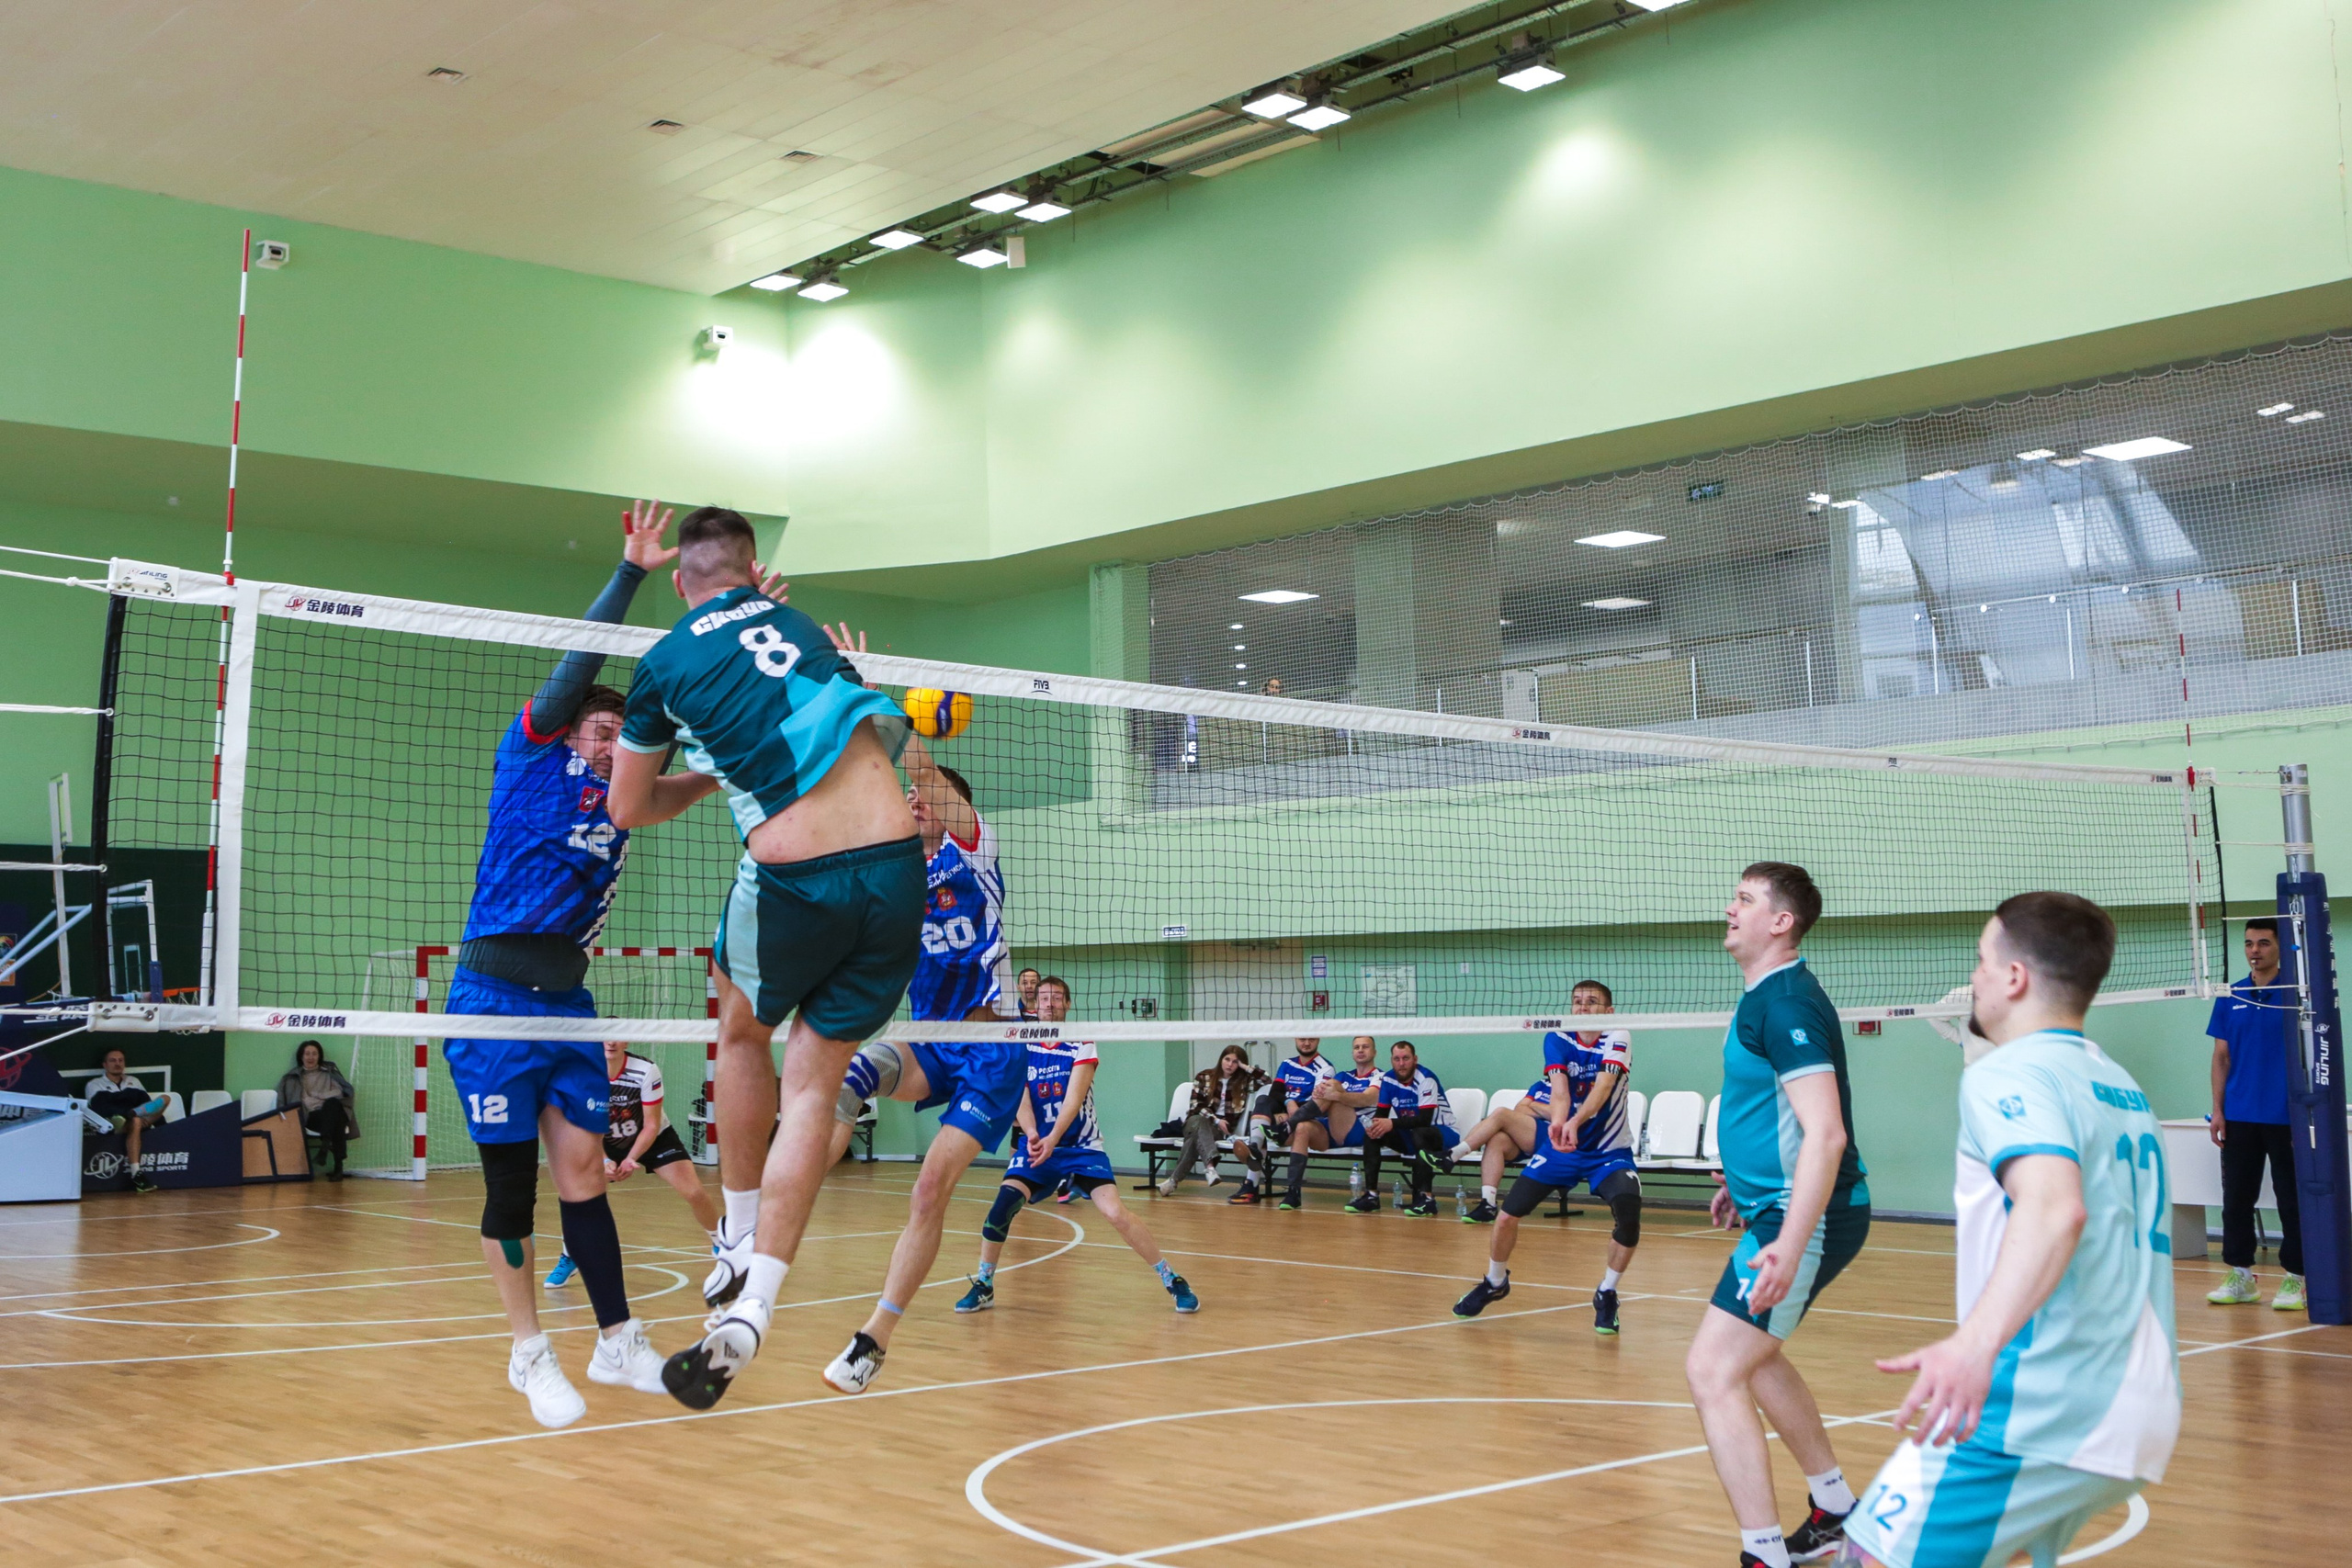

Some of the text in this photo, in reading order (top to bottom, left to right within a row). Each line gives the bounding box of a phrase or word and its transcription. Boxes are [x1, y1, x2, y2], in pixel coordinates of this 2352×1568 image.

[306, 599, 365, 617] 金陵体育
[739, 625, 801, 678] 8
[568, 822, 617, 862] 12
[921, 915, 977, 954] 20
[288, 1014, 346, 1028] 金陵体育
[2320, 1036, 2330, 1086] JINLING
[468, 1093, 509, 1123] 12
[609, 1120, 638, 1139] 18
[2116, 1133, 2171, 1256] 12
[1868, 1483, 1908, 1533] 12
